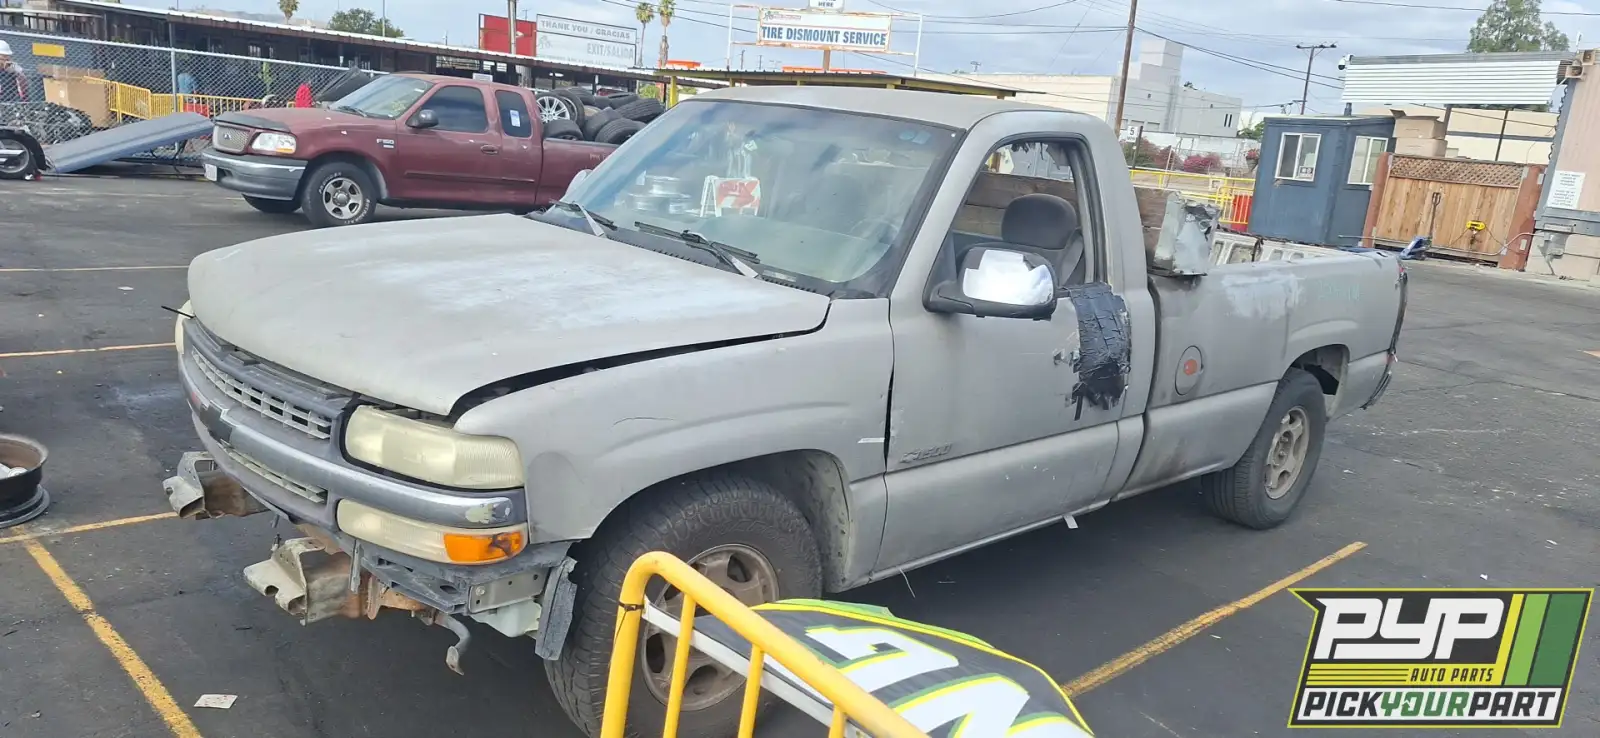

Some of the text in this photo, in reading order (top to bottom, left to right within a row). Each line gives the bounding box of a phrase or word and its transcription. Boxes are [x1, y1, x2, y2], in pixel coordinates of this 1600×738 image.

[541, 20, 569, 31] THANK
[572, 24, 588, 34] YOU
[596, 28, 630, 39] GRACIAS
[761, 26, 887, 46] TIRE DISMOUNT SERVICE
[586, 42, 634, 59] EXIT/SALIDA
[1129, 127, 1135, 136] 5
